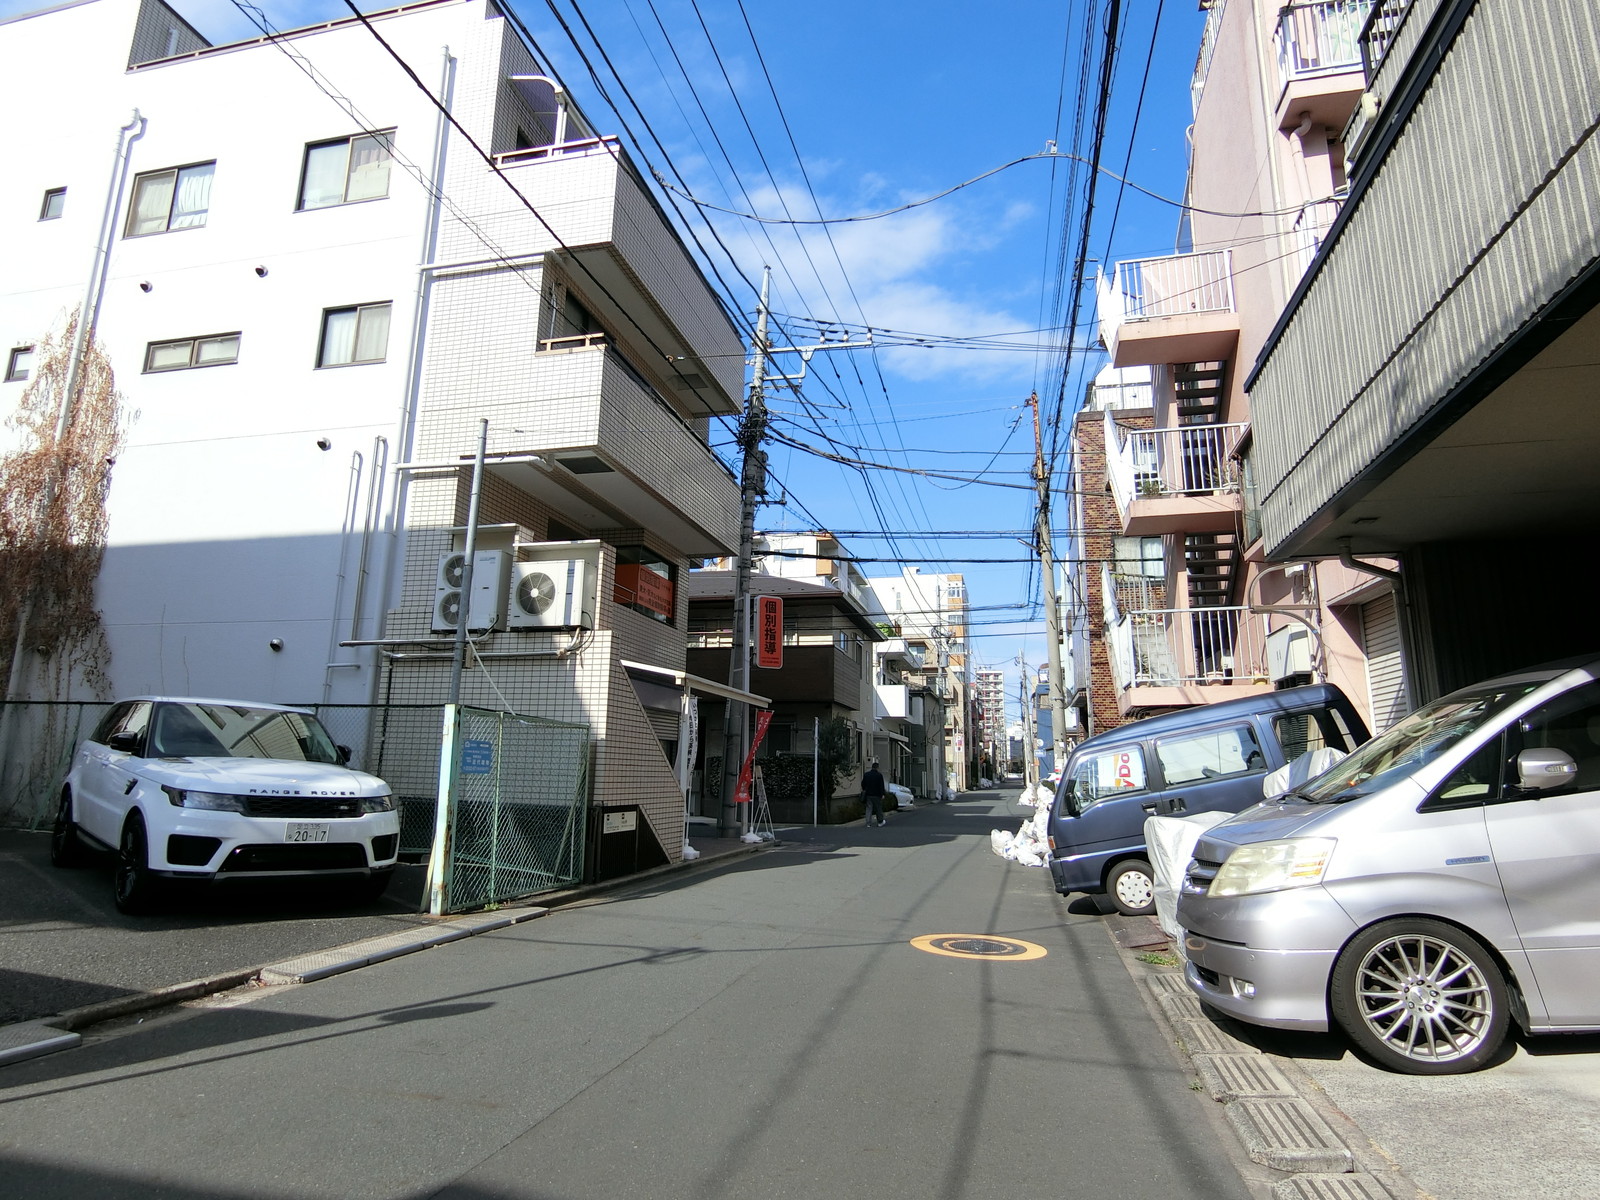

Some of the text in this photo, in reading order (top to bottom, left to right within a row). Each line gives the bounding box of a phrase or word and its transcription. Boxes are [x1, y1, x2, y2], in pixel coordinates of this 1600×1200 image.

[764, 600, 777, 655] 個別指導
[294, 830, 327, 842] 20-17
